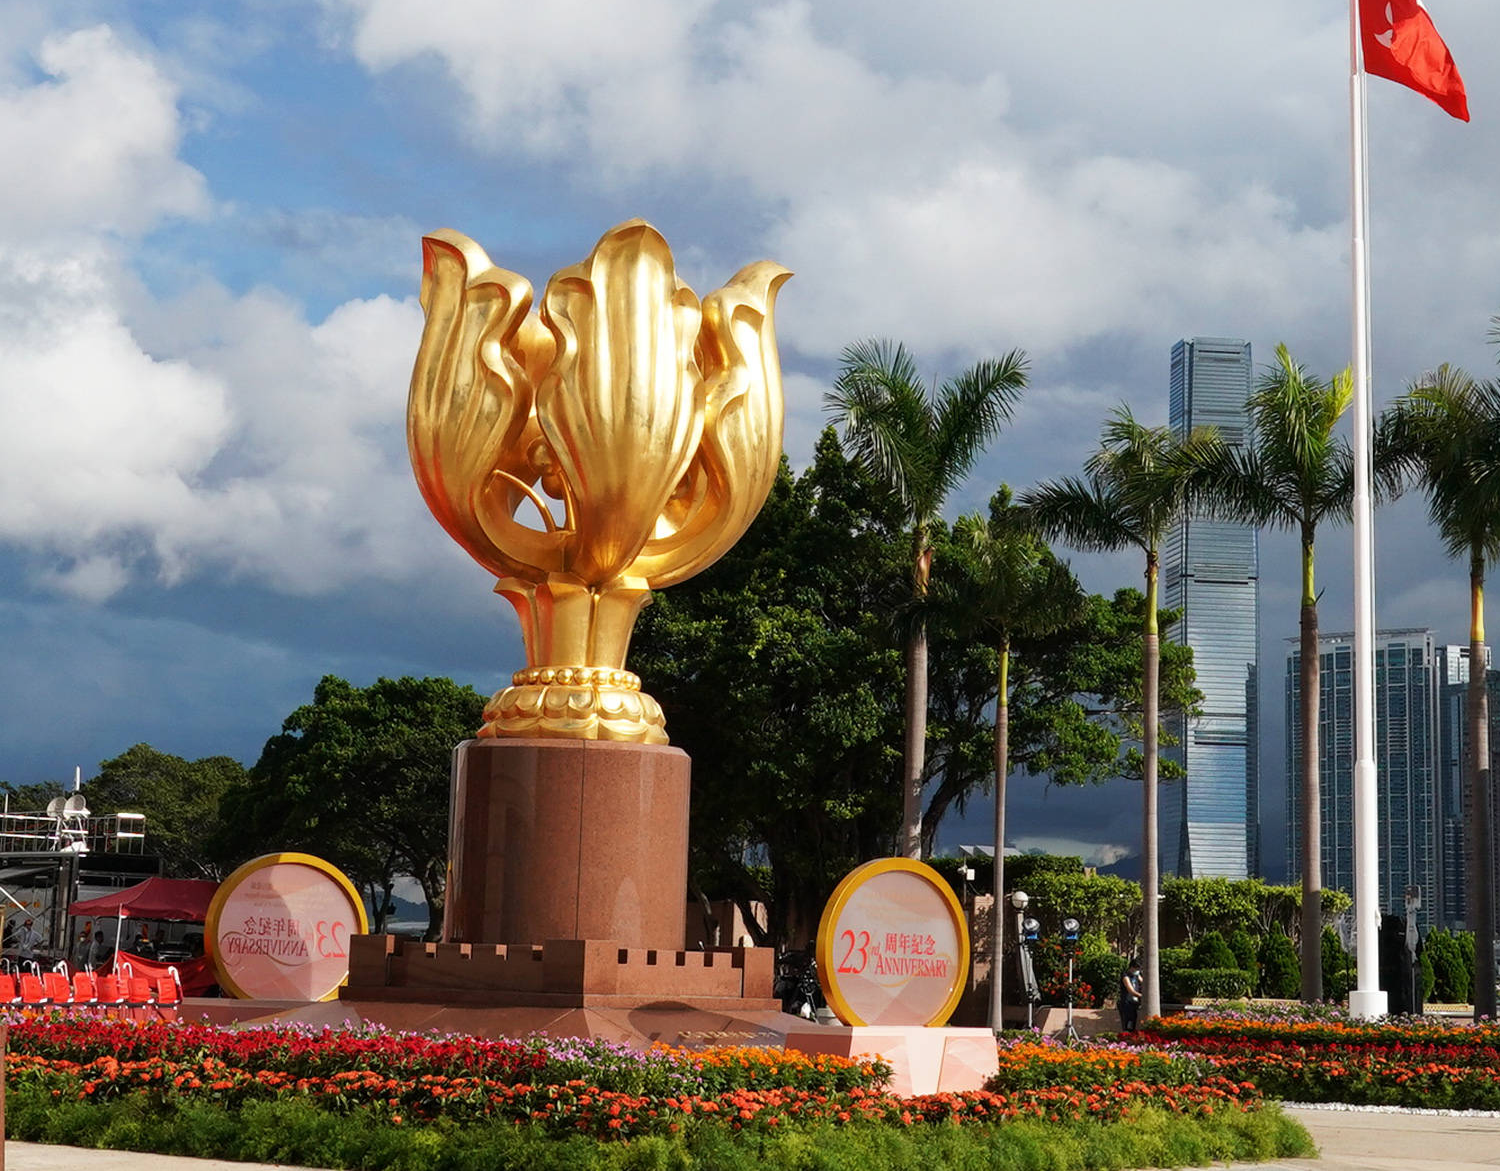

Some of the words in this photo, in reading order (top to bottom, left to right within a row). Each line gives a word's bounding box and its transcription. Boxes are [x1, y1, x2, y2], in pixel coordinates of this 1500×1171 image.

[885, 932, 937, 956] 周年紀念
[874, 954, 949, 978] ANNIVERSARY
